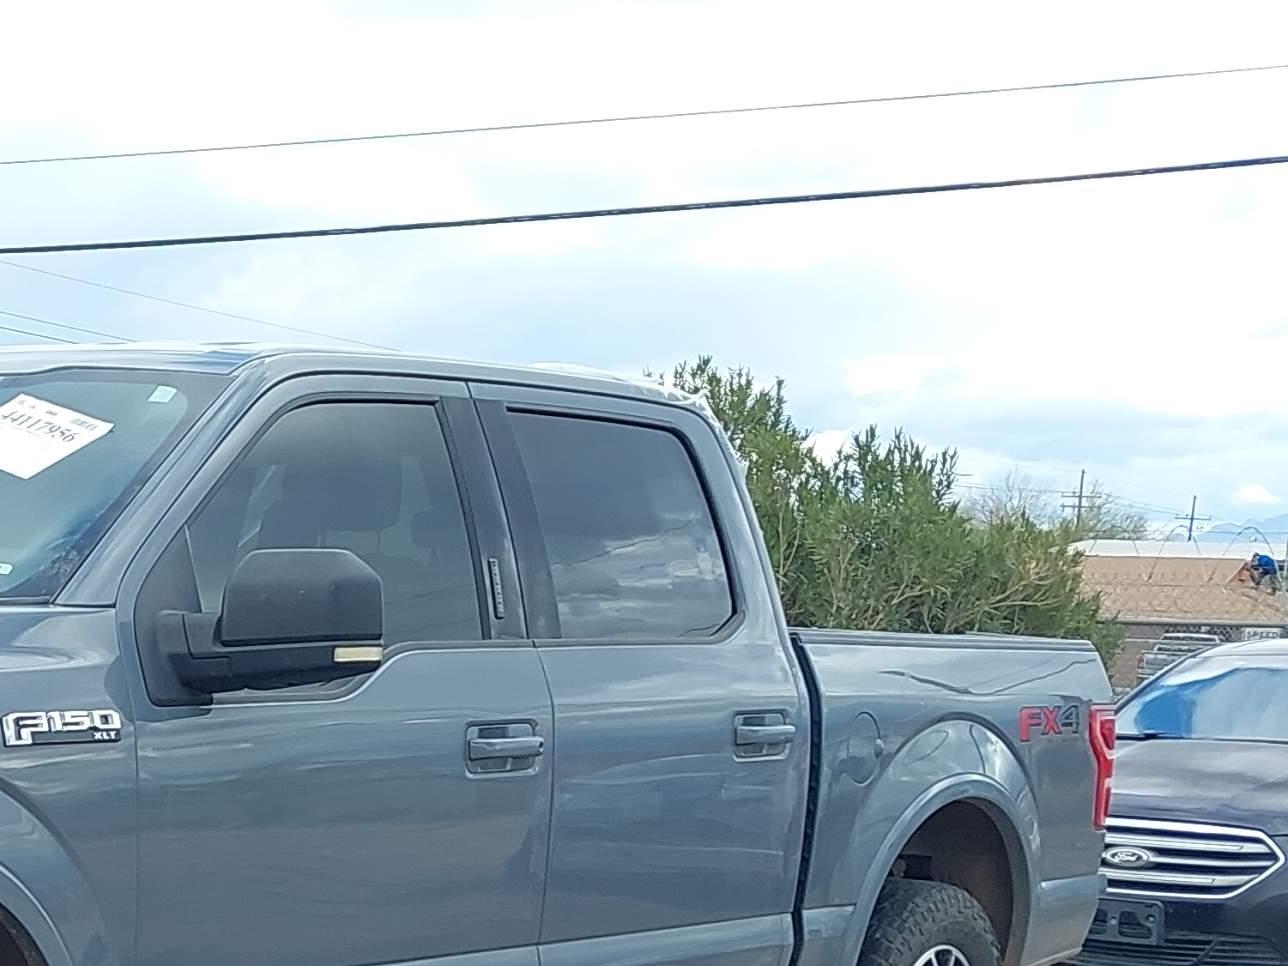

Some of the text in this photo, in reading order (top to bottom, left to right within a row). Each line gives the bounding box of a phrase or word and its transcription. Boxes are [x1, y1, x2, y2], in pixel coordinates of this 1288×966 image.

[0, 410, 80, 443] 44117956
[1246, 630, 1279, 639] SPEED
[1019, 704, 1080, 742] FX4
[93, 731, 117, 740] XLT
